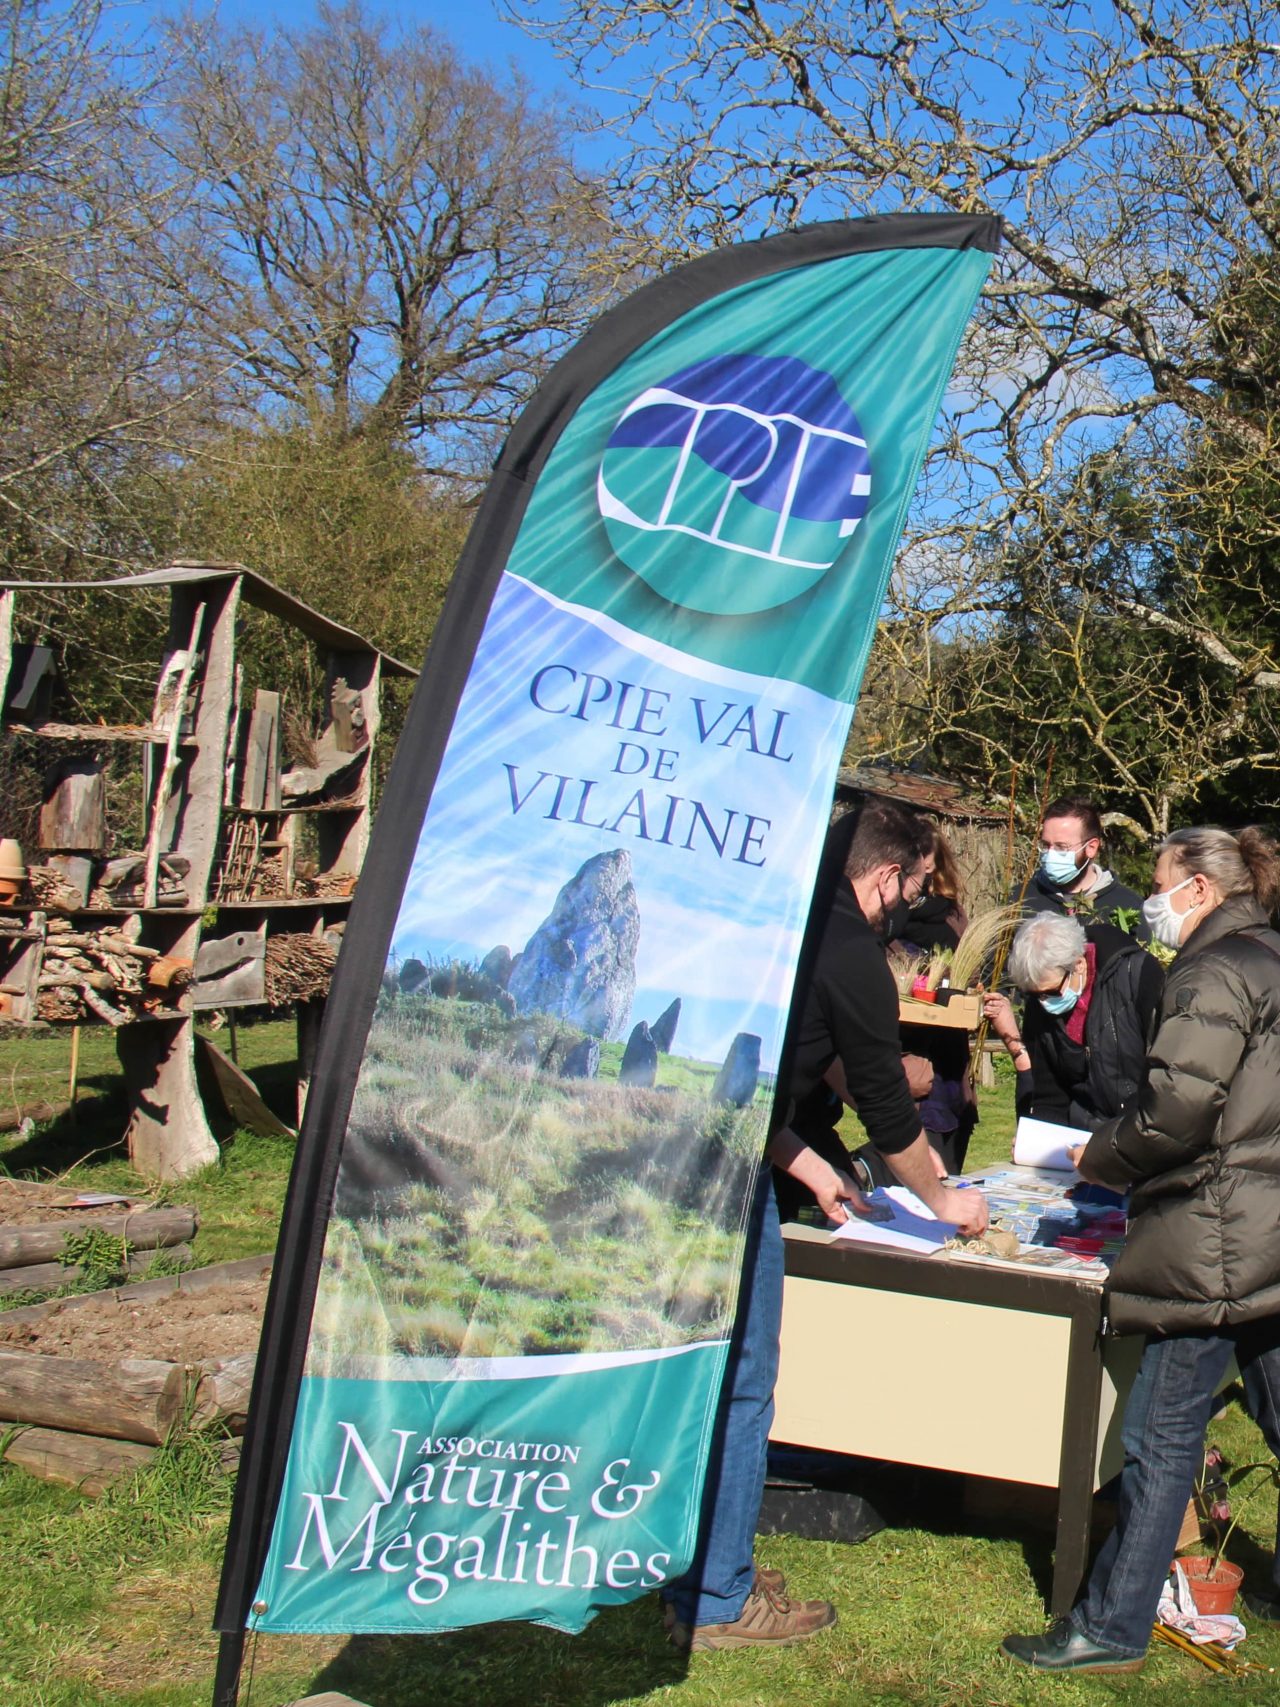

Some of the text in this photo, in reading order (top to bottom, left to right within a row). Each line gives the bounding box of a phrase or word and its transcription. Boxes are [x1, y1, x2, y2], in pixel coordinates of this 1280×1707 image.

[529, 663, 794, 763] CPIE VAL
[610, 741, 681, 783] DE
[501, 762, 772, 868] VILAINE
[324, 1421, 661, 1520] Nature &
[416, 1436, 582, 1465] ASSOCIATION
[283, 1491, 672, 1606] Mégalithes
